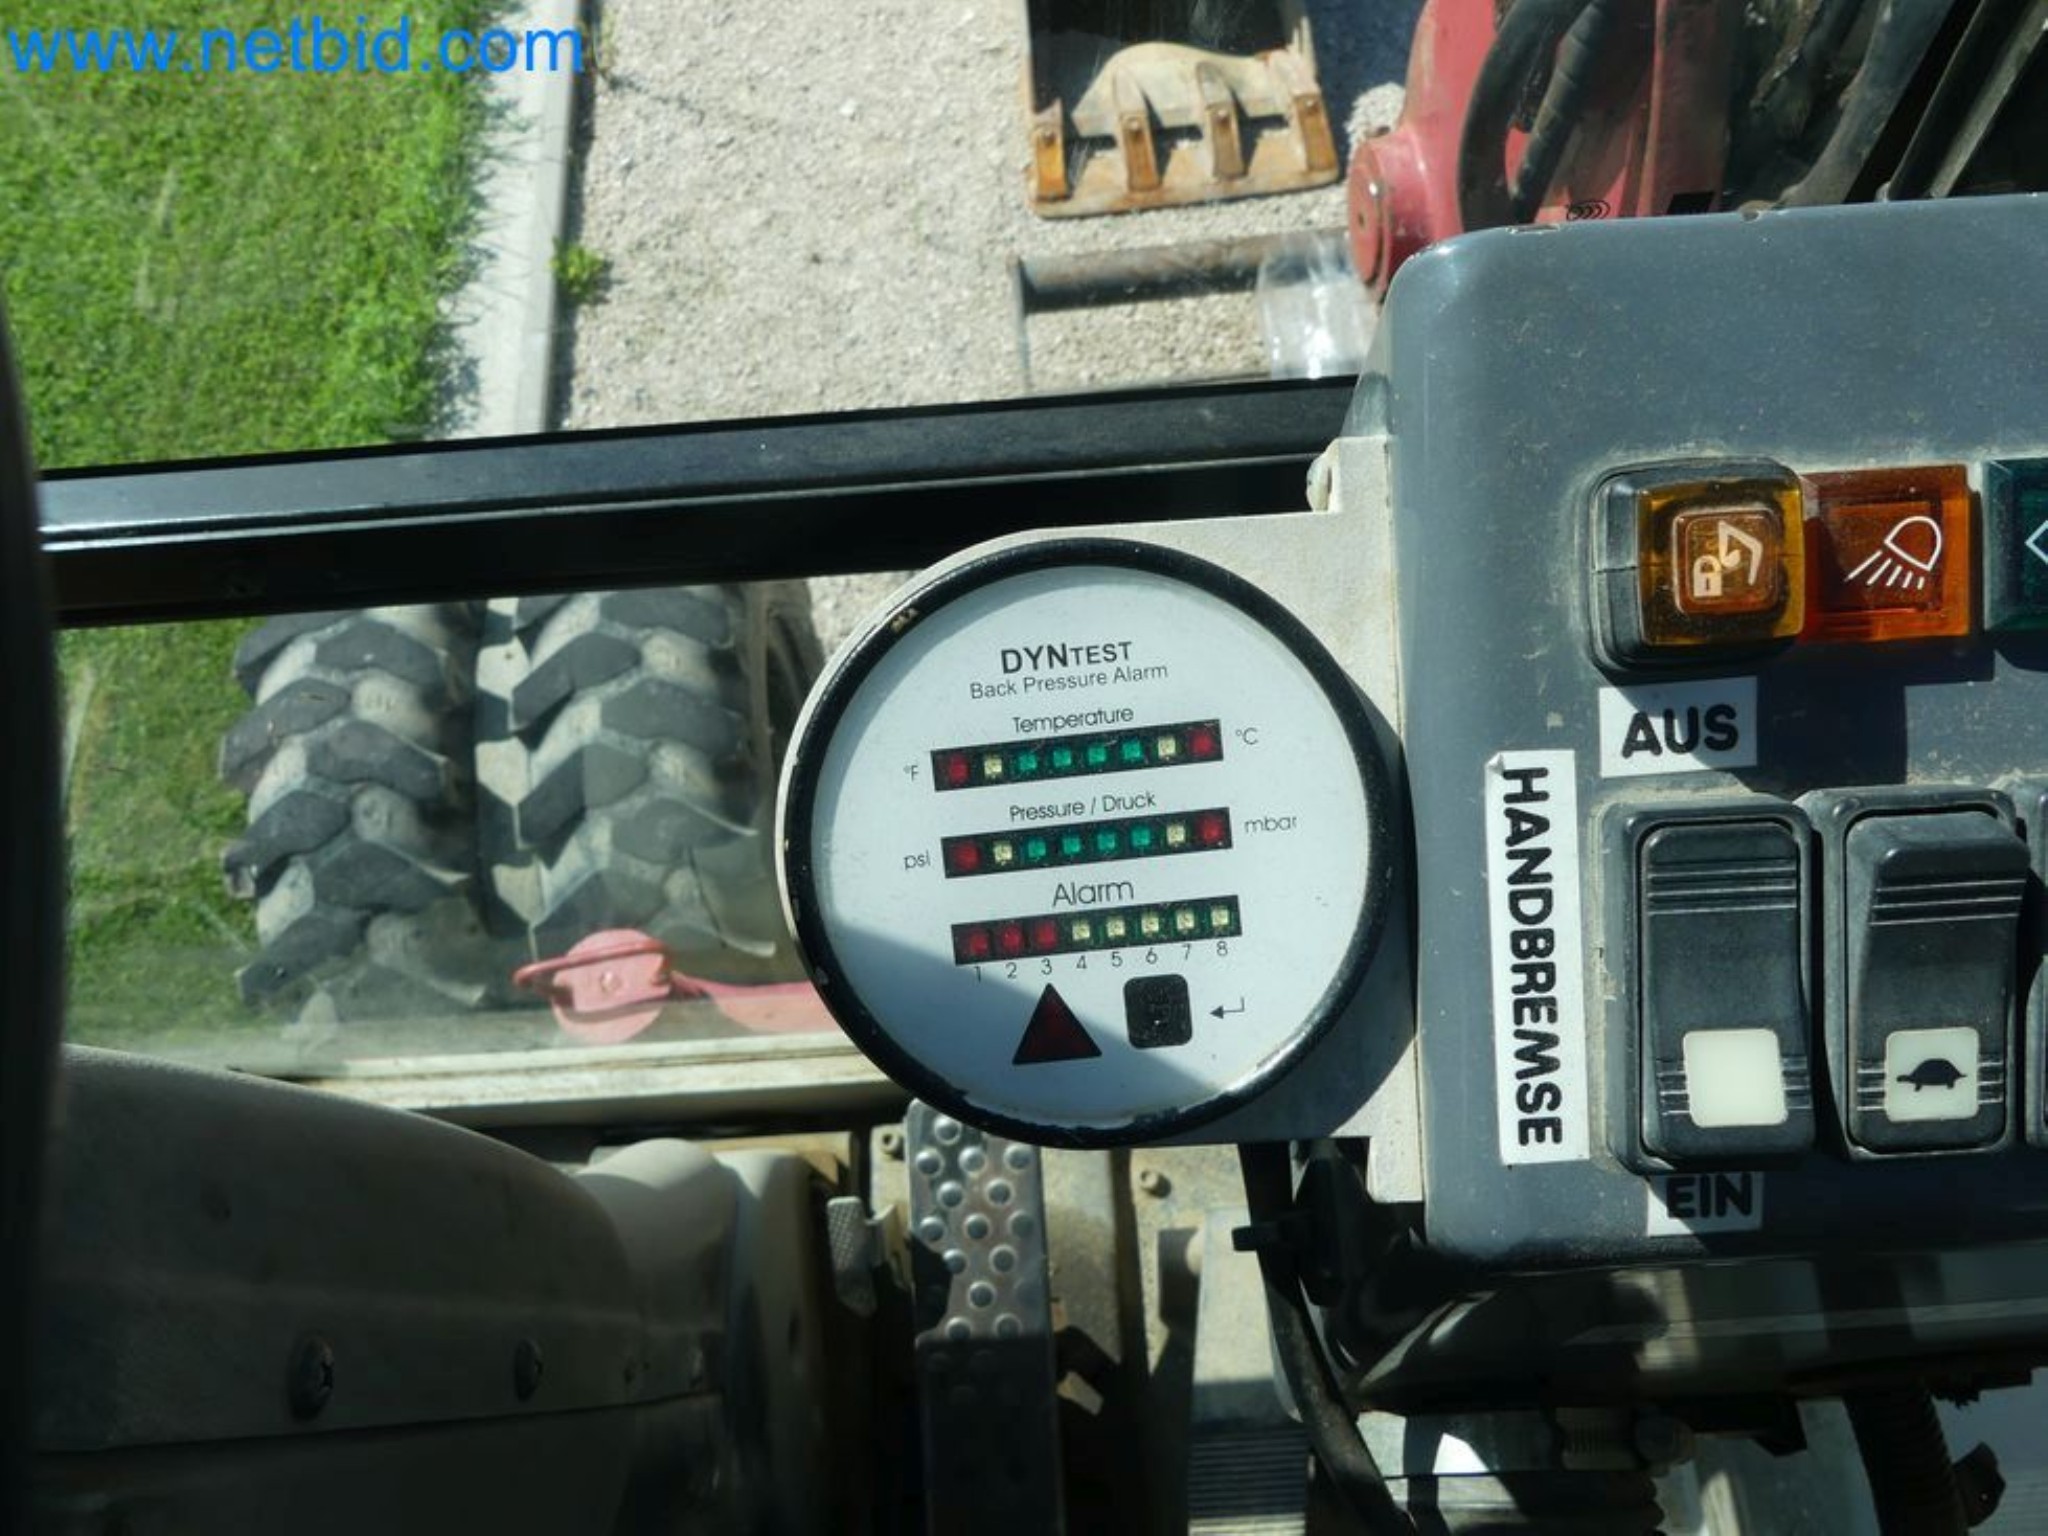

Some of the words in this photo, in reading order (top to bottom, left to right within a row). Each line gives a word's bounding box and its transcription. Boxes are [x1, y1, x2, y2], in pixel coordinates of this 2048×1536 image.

[970, 680, 1017, 700] Back
[1023, 670, 1107, 694] Pressure
[1114, 663, 1169, 682] Alarm
[1013, 706, 1134, 734] Temperature
[1621, 704, 1739, 759] AUS
[1009, 800, 1085, 822] Pressure
[1103, 791, 1156, 812] Druck
[1244, 814, 1298, 834] mbar
[904, 850, 931, 872] psi
[1052, 879, 1135, 907] Alarm
[1006, 963, 1018, 979] 2
[1041, 959, 1053, 976] 3
[1076, 955, 1088, 971] 4
[1111, 951, 1123, 967] 5
[1146, 947, 1158, 964] 6
[1181, 944, 1192, 961] 7
[1216, 941, 1229, 957] 8
[1503, 766, 1562, 1148] HANDBREMSE
[1667, 1174, 1753, 1218] EIN
